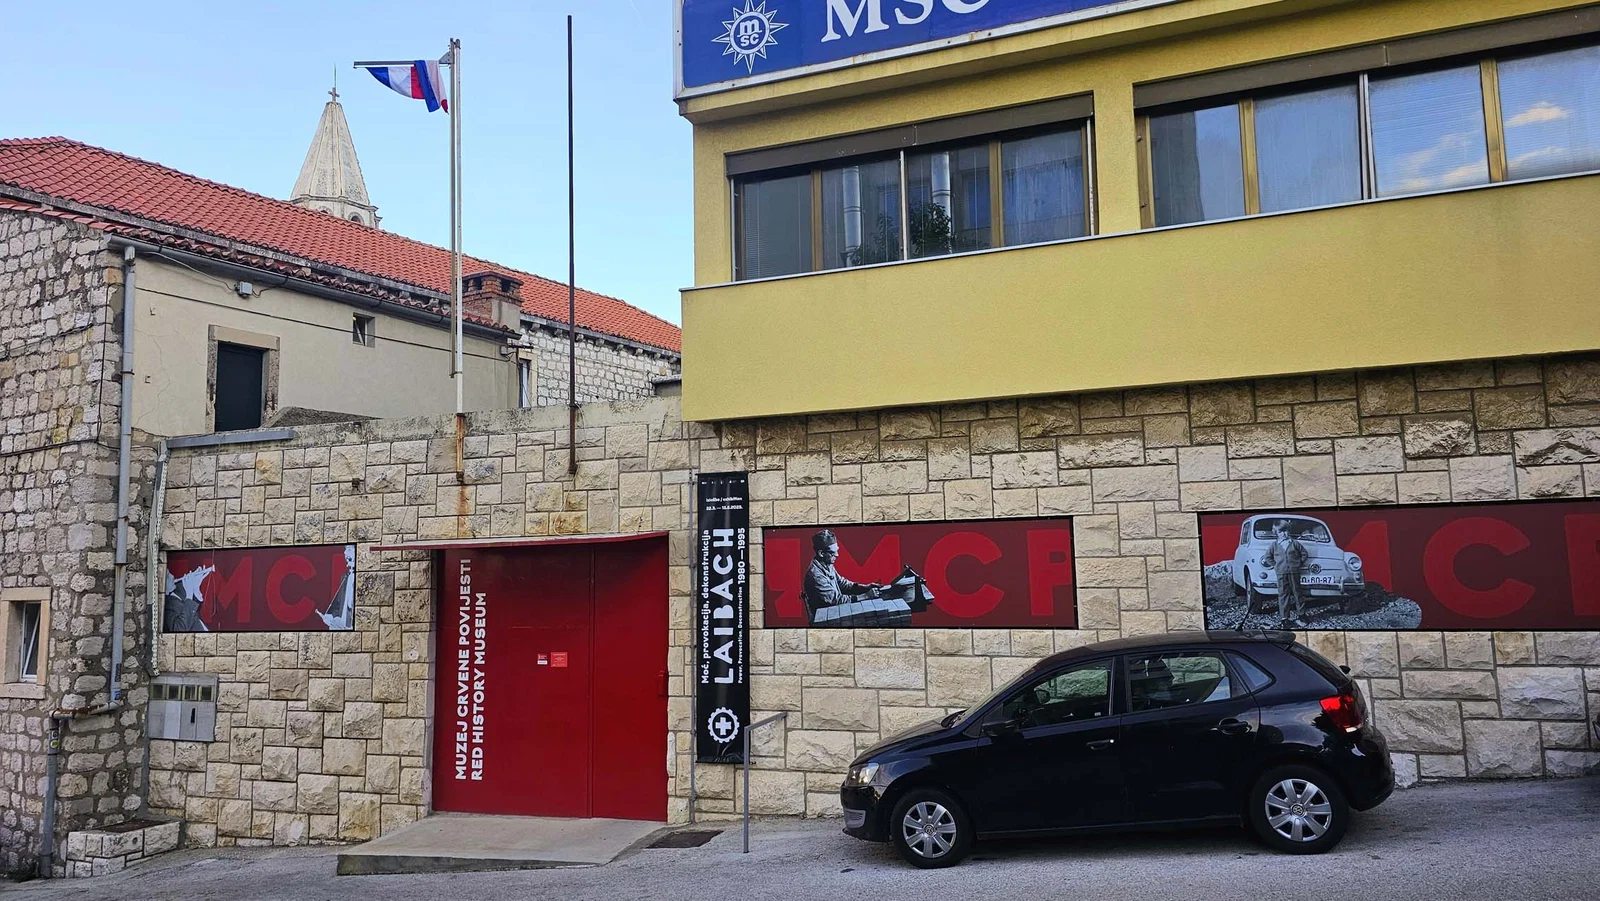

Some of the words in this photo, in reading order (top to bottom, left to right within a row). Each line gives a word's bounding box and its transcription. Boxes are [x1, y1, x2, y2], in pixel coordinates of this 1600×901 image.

[700, 529, 711, 598] dekonstrukcija
[459, 559, 471, 645] POVIJESTI
[474, 592, 487, 665] MUSEUM
[701, 601, 711, 659] provokacija,
[709, 528, 735, 684] LAIBACH
[457, 650, 470, 717] CRVENE
[472, 668, 485, 744] HISTORY
[701, 661, 711, 684] Moć,
[455, 721, 468, 780] MUZEJ
[471, 747, 483, 780] RED
